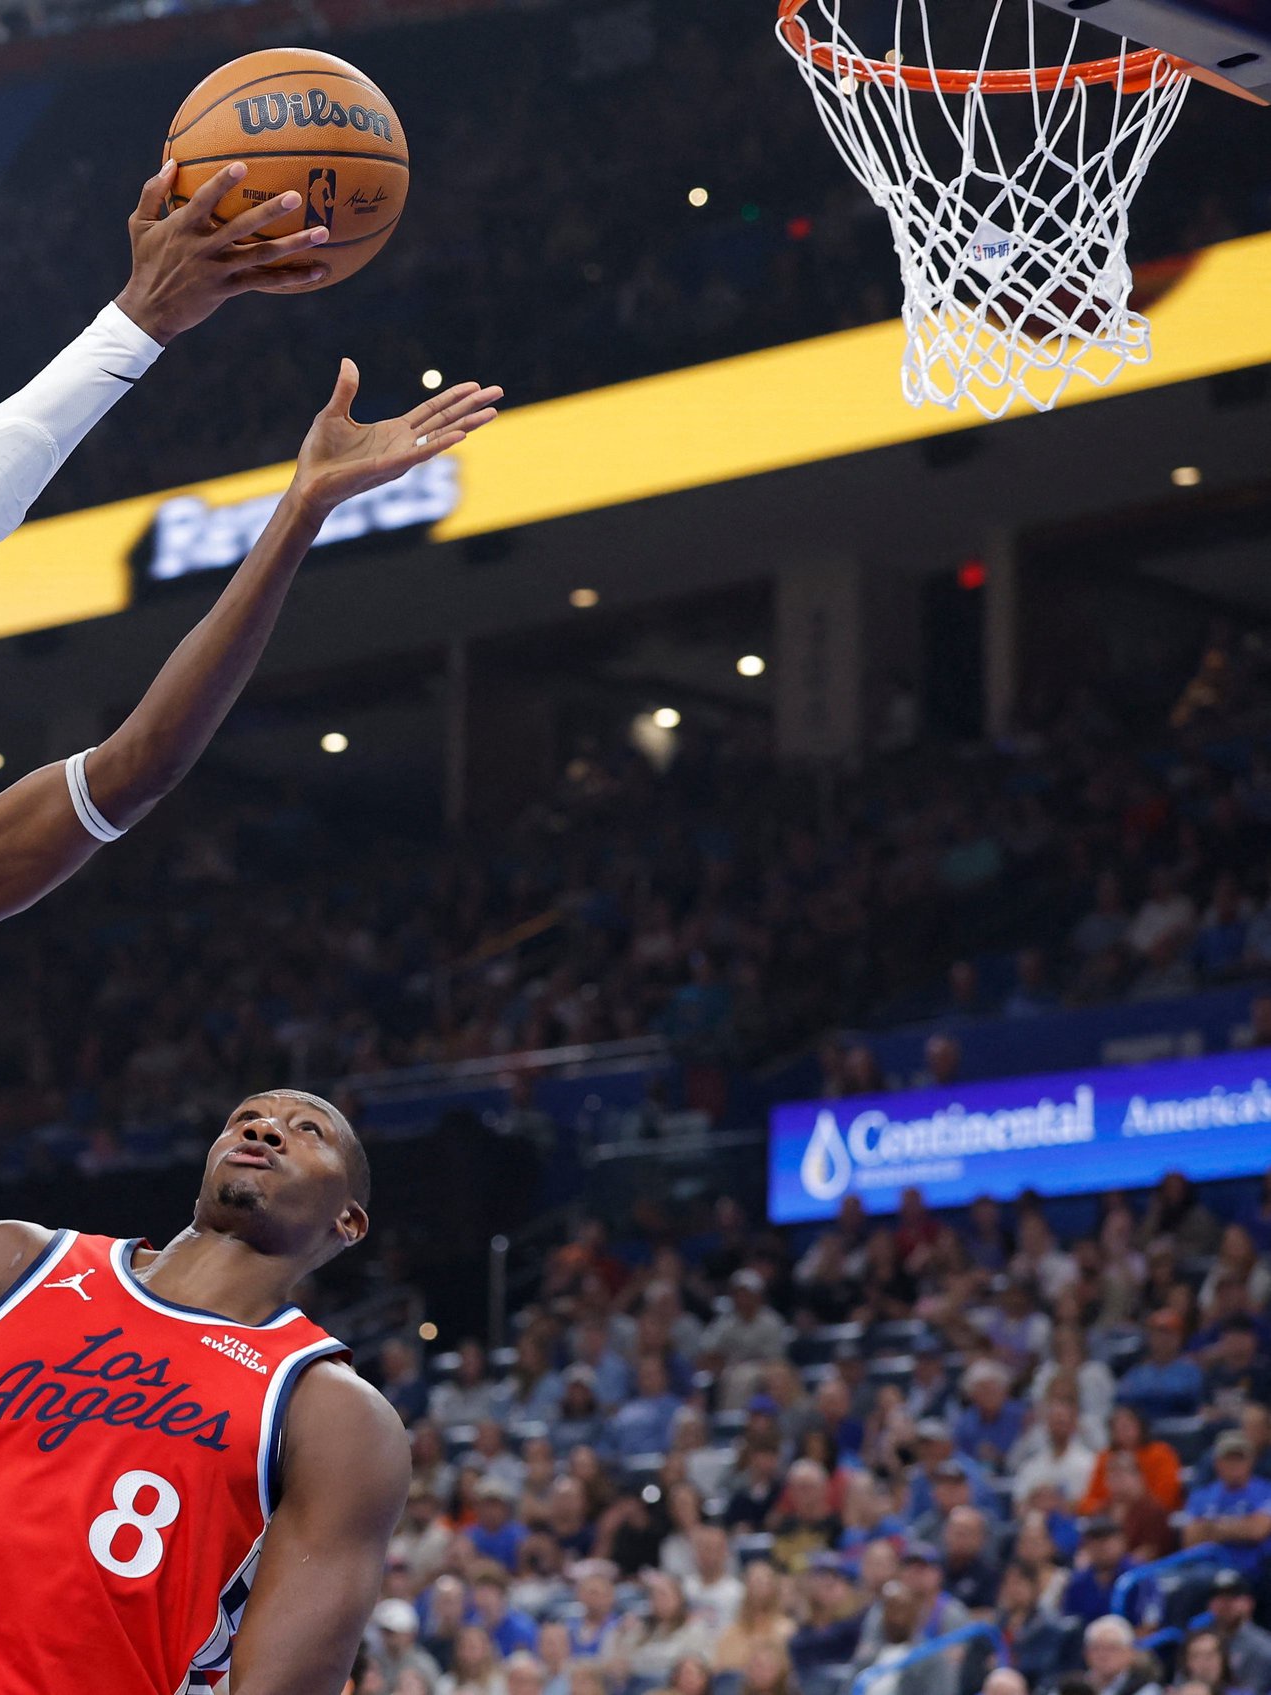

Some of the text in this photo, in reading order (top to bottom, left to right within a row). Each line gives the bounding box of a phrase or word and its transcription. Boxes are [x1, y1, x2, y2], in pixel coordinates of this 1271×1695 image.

[233, 88, 393, 143] Wilson
[848, 1084, 1096, 1166] Continental
[53, 1327, 171, 1387] Los
[200, 1335, 268, 1375] RWANDA
[223, 1334, 262, 1361] VISIT
[88, 1470, 180, 1578] 8
